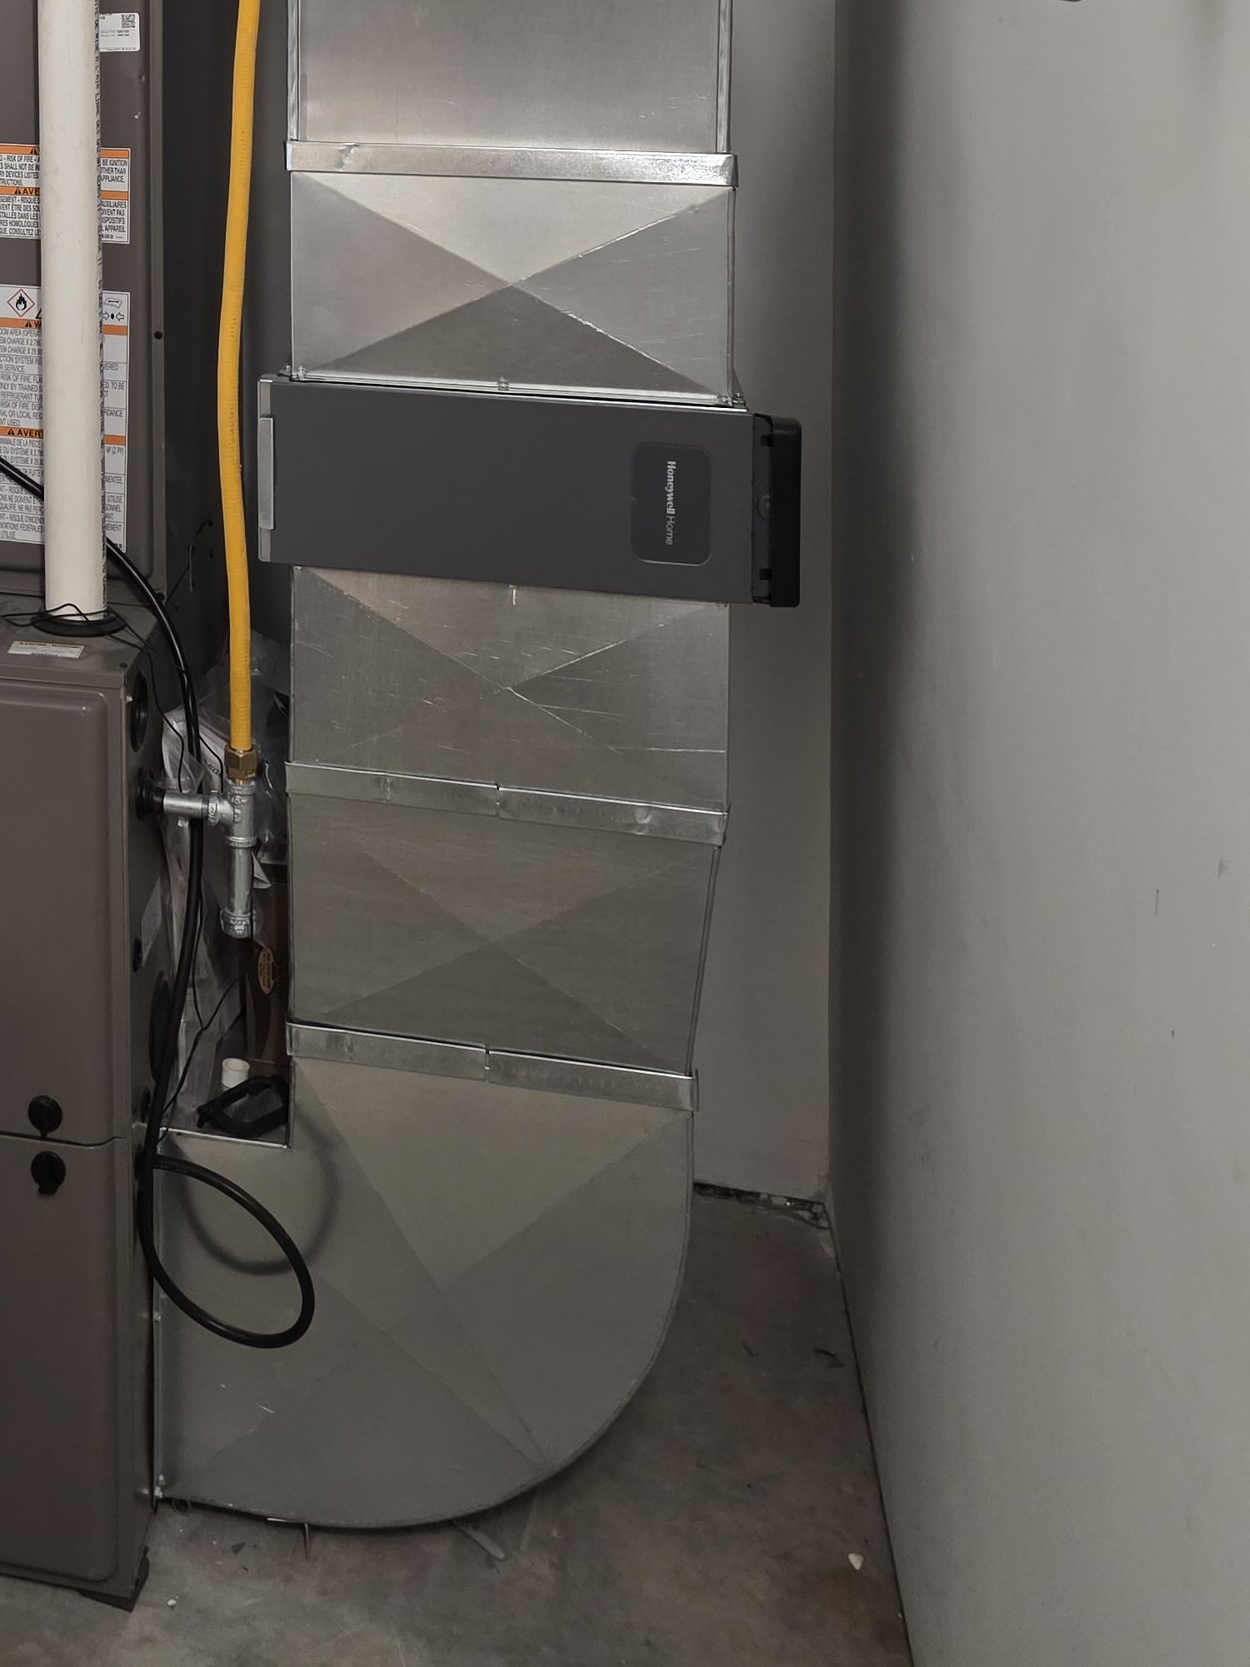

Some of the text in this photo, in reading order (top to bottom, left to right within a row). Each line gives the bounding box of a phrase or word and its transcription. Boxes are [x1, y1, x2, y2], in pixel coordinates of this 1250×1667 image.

[109, 159, 127, 167] IGNITION
[664, 461, 677, 545] Honeywell Home
